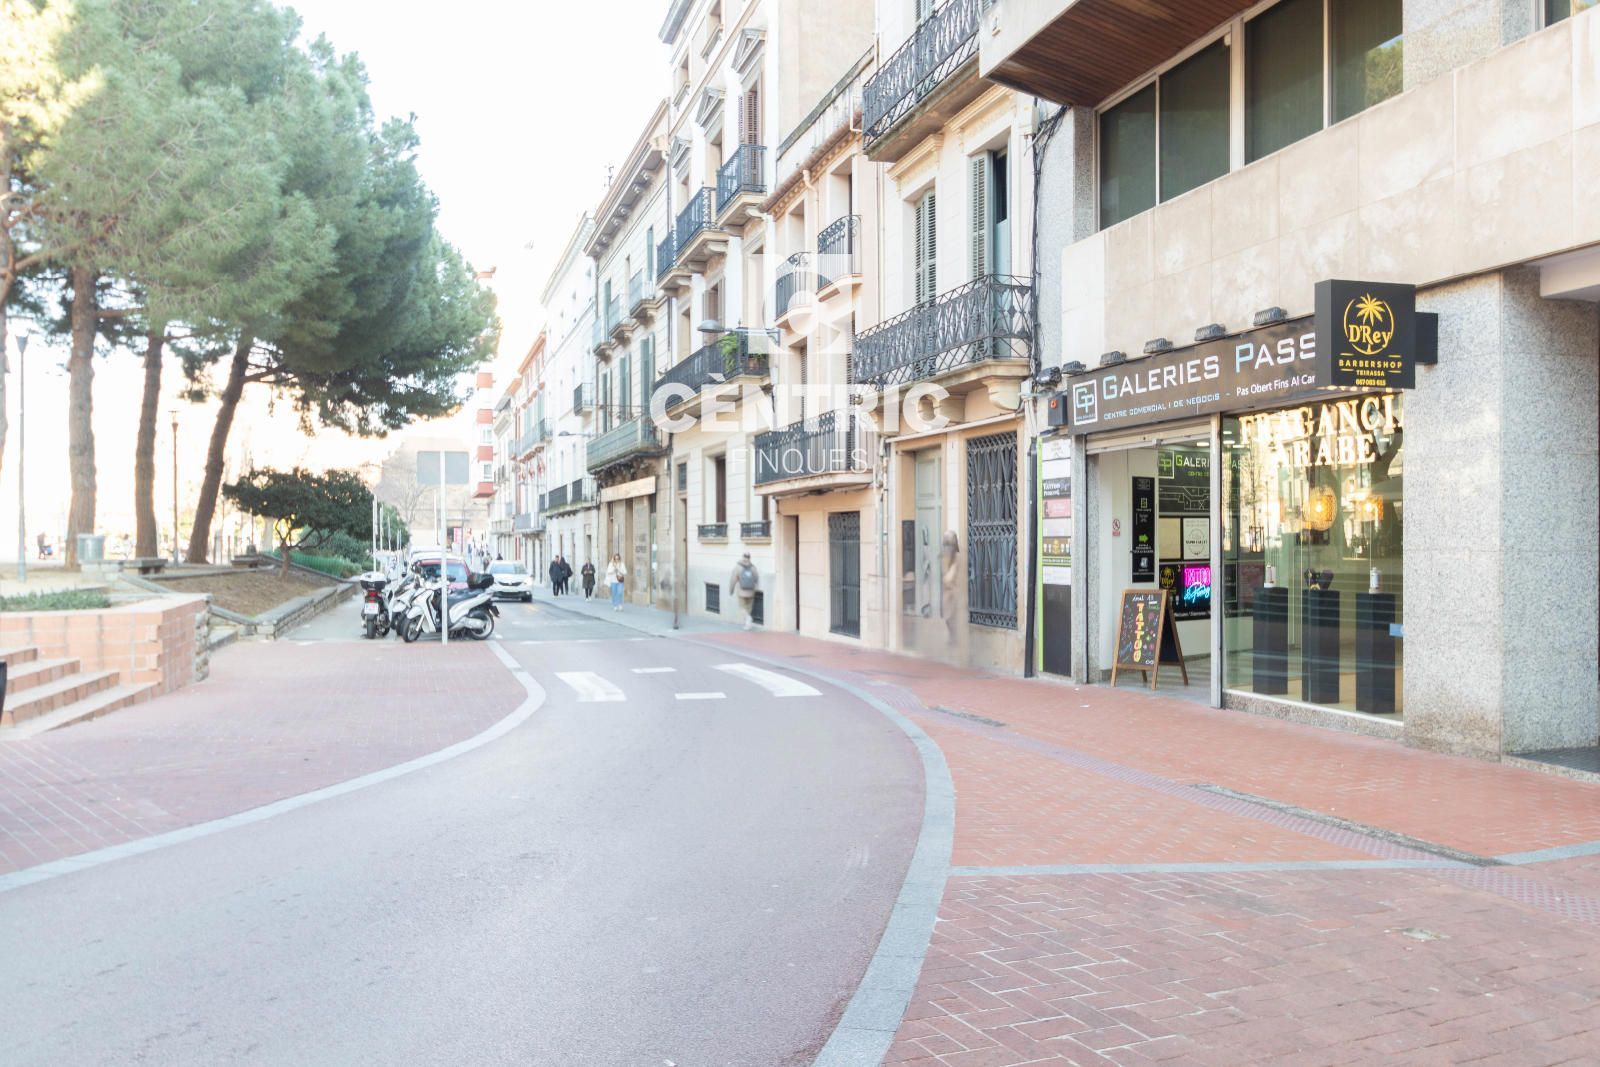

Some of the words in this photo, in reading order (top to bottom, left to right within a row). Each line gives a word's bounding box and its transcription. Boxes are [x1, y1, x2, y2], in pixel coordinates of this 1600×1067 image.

[1349, 324, 1391, 348] D'Rey
[1338, 359, 1403, 368] BARBERSHOP
[1103, 355, 1219, 400] GALERIES
[1236, 385, 1249, 396] Pas
[1250, 381, 1273, 394] Obert
[1274, 378, 1289, 390] Fins
[1291, 376, 1300, 387] Al
[1103, 409, 1128, 420] CENTRE
[1129, 402, 1166, 416] COMERCIAL
[1173, 399, 1184, 408] DE
[1186, 392, 1220, 406] NEGOCIS
